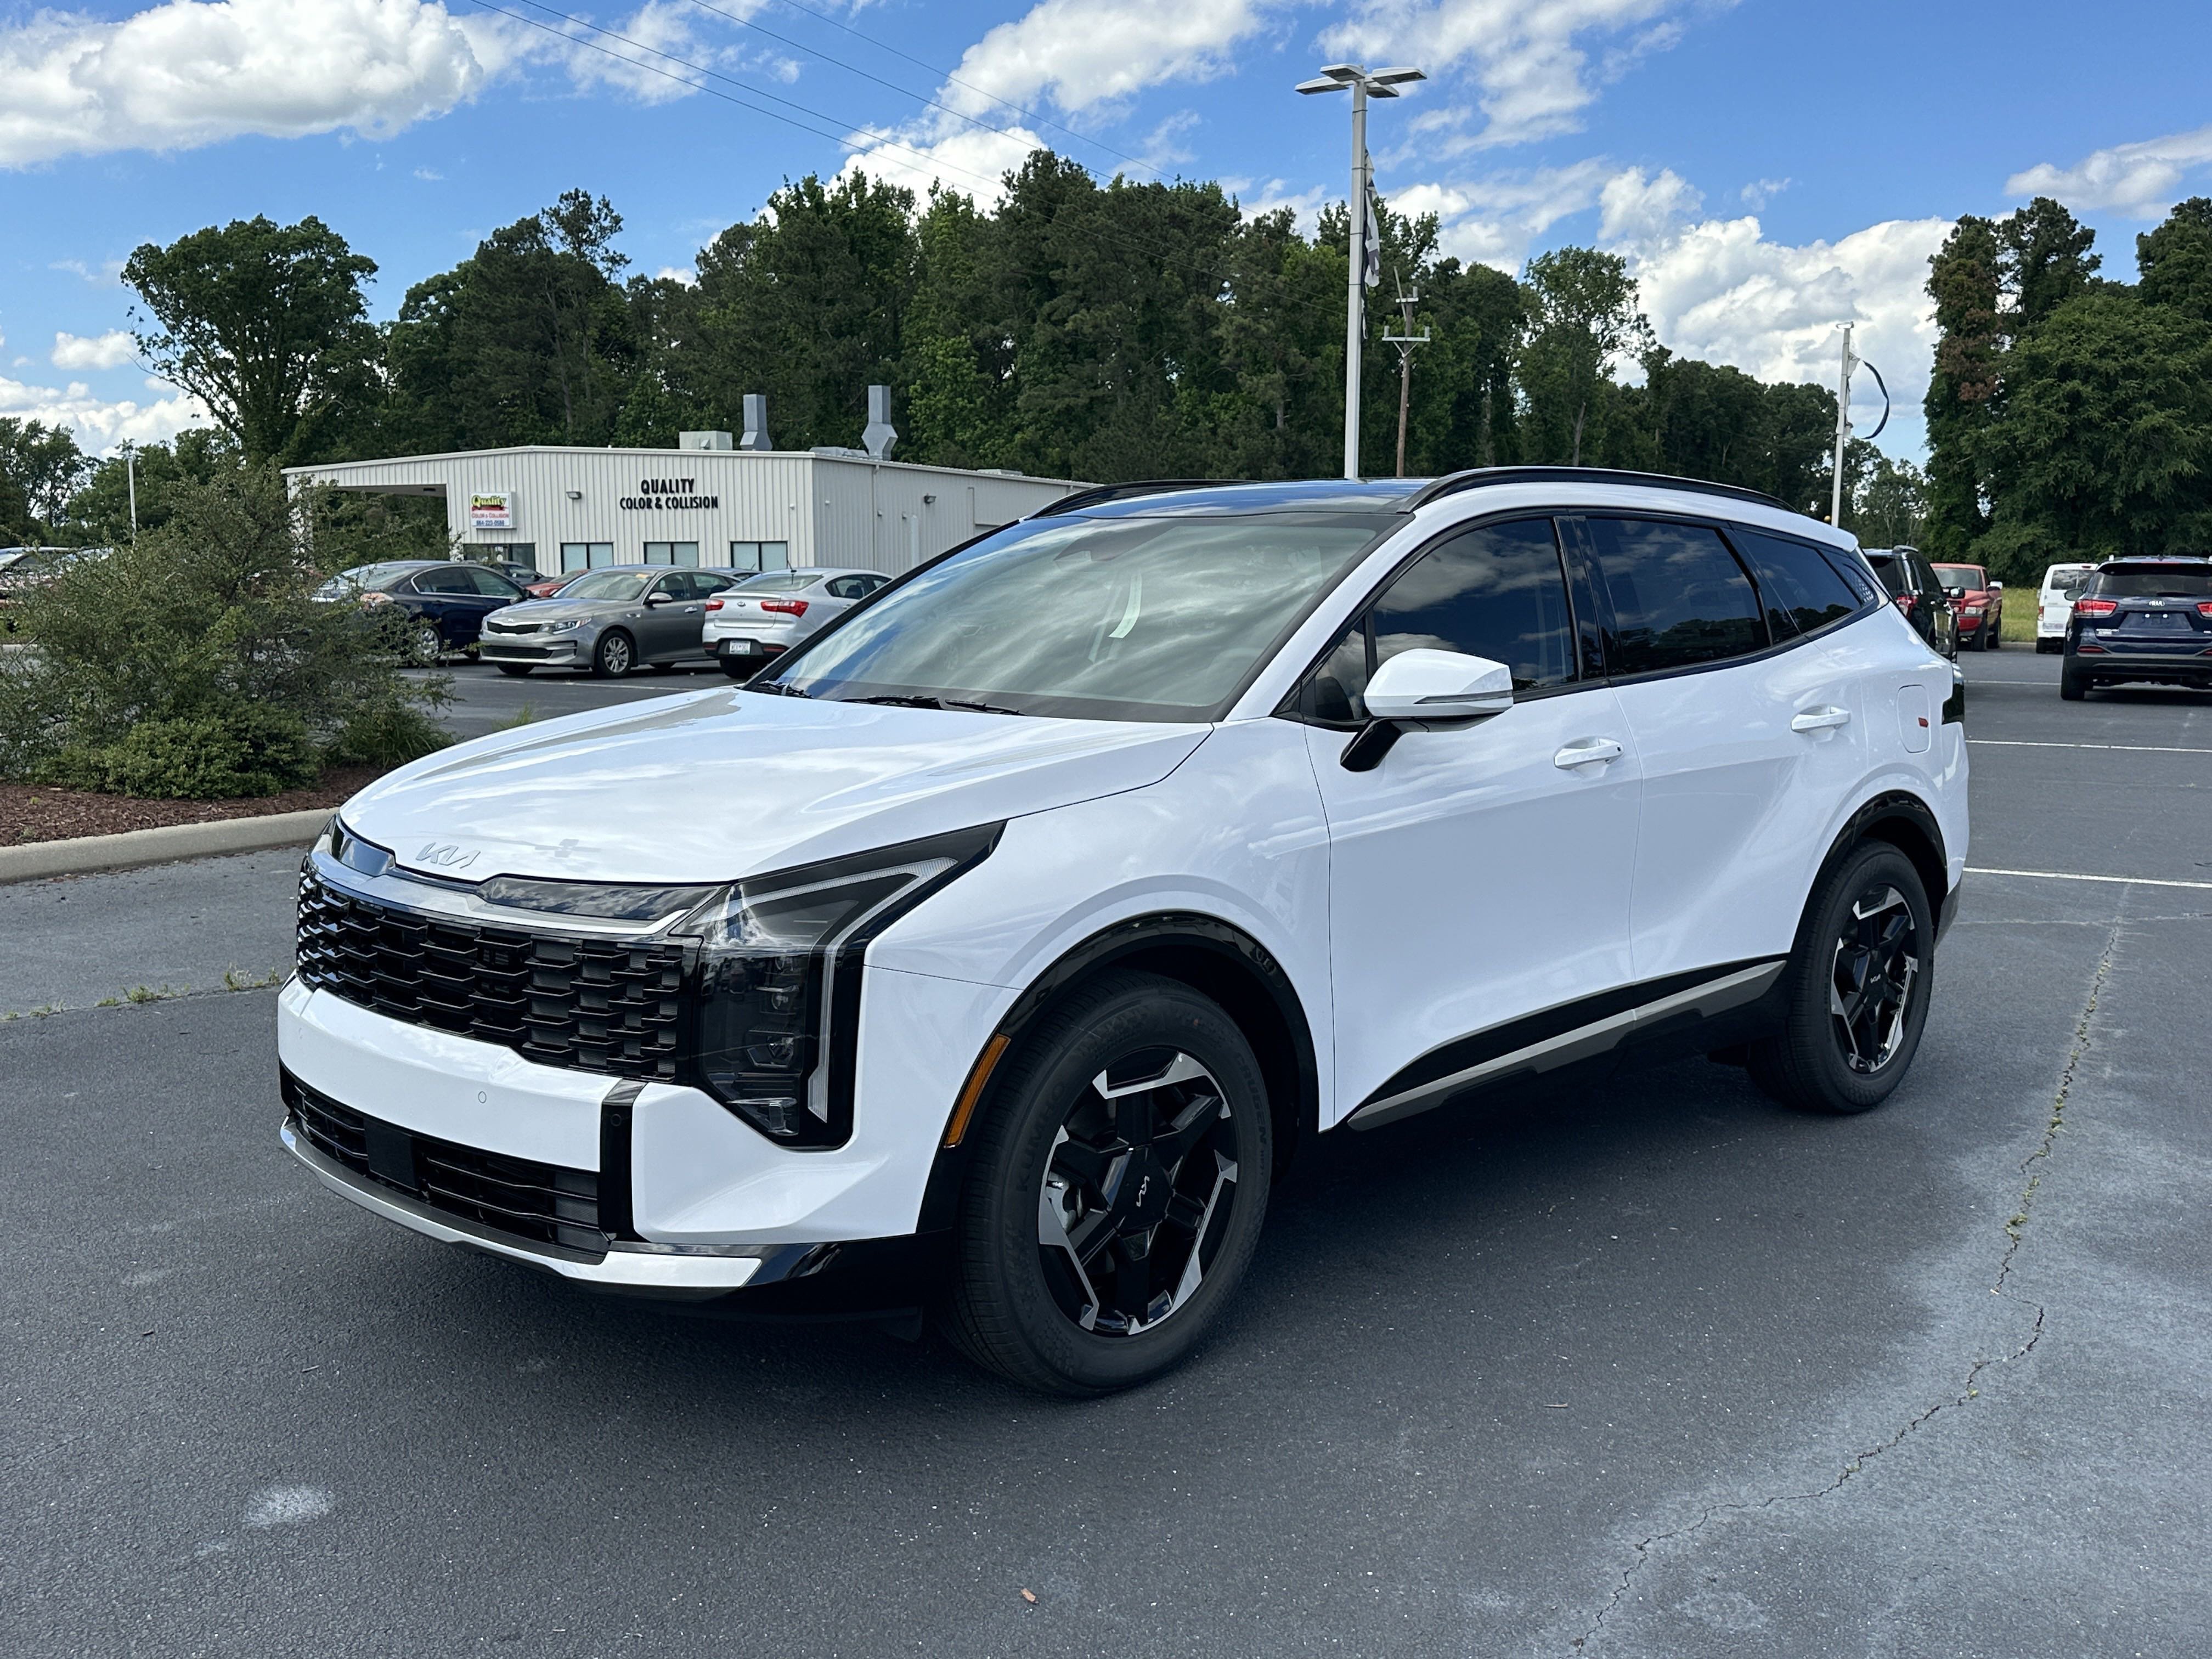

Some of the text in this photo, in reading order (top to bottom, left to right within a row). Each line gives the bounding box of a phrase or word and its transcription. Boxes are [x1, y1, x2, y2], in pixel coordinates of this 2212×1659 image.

[641, 478, 695, 494] QUALITY
[472, 495, 506, 507] Quality
[620, 496, 718, 510] COLOR & COLLISION
[416, 842, 481, 869] KIA
[1237, 1052, 1267, 1146] CRUGEN
[1016, 1081, 1065, 1192] KUMHO
